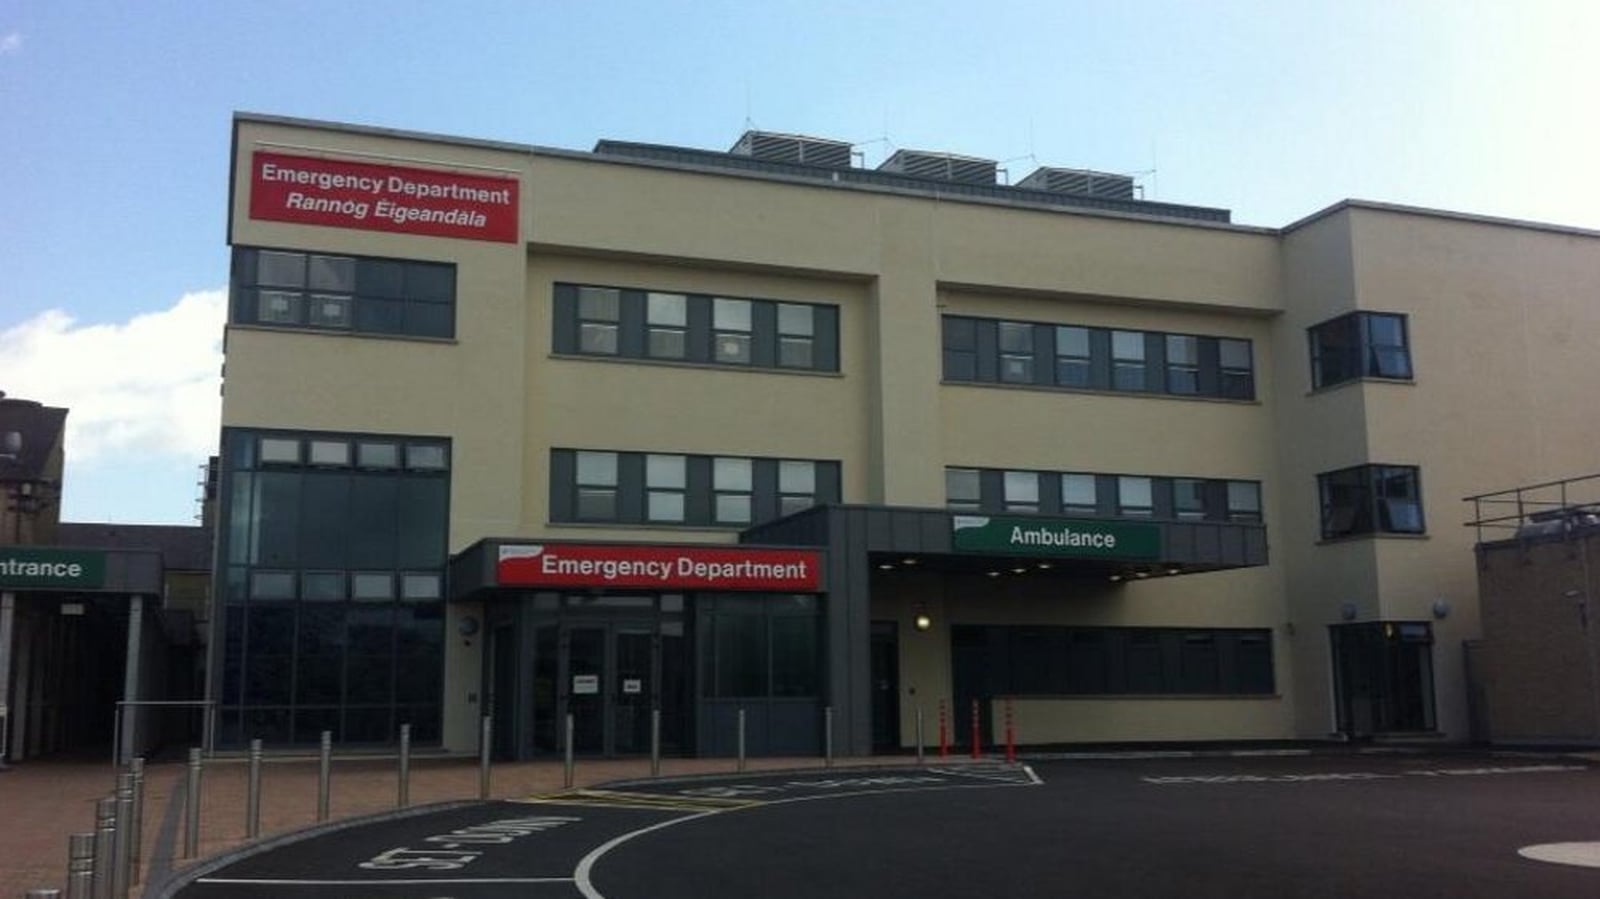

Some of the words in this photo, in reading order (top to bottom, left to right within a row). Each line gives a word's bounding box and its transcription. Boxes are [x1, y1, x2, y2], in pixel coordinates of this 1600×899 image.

[261, 164, 383, 193] Emergency
[388, 177, 510, 204] Department
[1010, 526, 1116, 548] Ambulance
[541, 554, 672, 579] Emergency
[677, 557, 807, 581] Department
